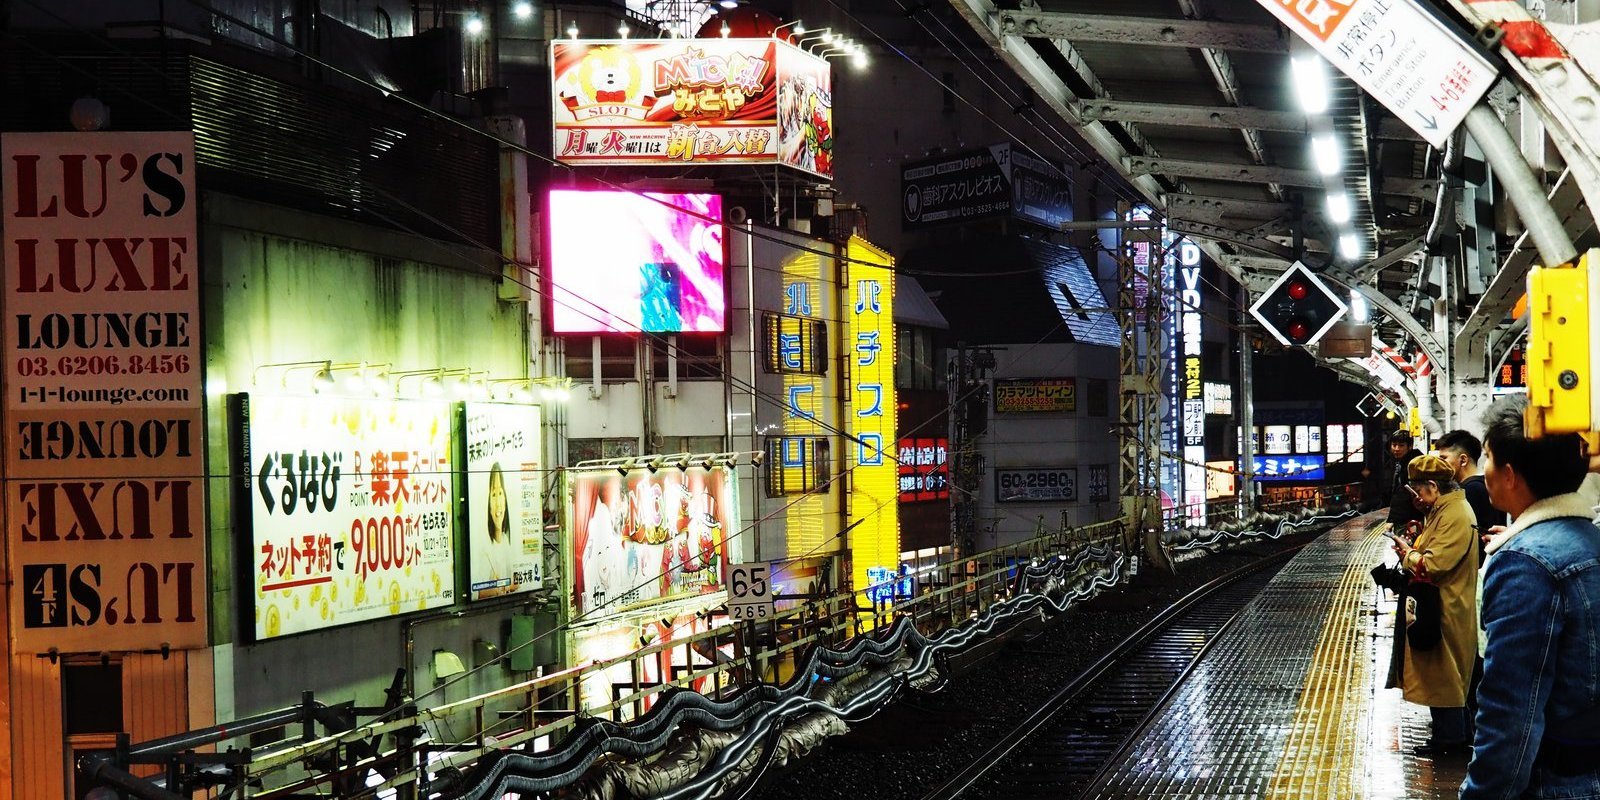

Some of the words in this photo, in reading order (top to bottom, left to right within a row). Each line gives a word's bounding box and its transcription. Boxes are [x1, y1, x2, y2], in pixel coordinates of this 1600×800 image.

[1357, 29, 1396, 77] ボタン
[1372, 38, 1417, 91] Emergency
[1385, 73, 1408, 100] Train
[1405, 48, 1428, 73] Stop
[1396, 77, 1426, 109] Button
[588, 106, 632, 118] SLOT
[673, 87, 745, 112] みとや
[1000, 149, 1009, 165] 2F
[12, 152, 186, 218] LU'S
[922, 174, 1003, 206] 歯科アスクレピオス
[15, 237, 189, 293] LUXE
[16, 312, 190, 350] LOUNGE
[17, 354, 190, 377] 03.6206.8456
[855, 280, 884, 466] パチスロ
[997, 386, 1073, 398] カラマツトレイン
[18, 420, 192, 460] LOUNGE
[1187, 437, 1202, 445] 5F
[258, 449, 342, 516] ぐるなび
[370, 449, 410, 506] 楽天
[412, 480, 447, 505] ポイント
[20, 480, 193, 542] LUXE
[350, 491, 369, 507] POINT
[261, 533, 344, 578] ネット予約で
[352, 515, 405, 583] 9,000
[69, 562, 196, 626] LU'S
[731, 568, 767, 598] 65
[734, 606, 767, 619] 265
